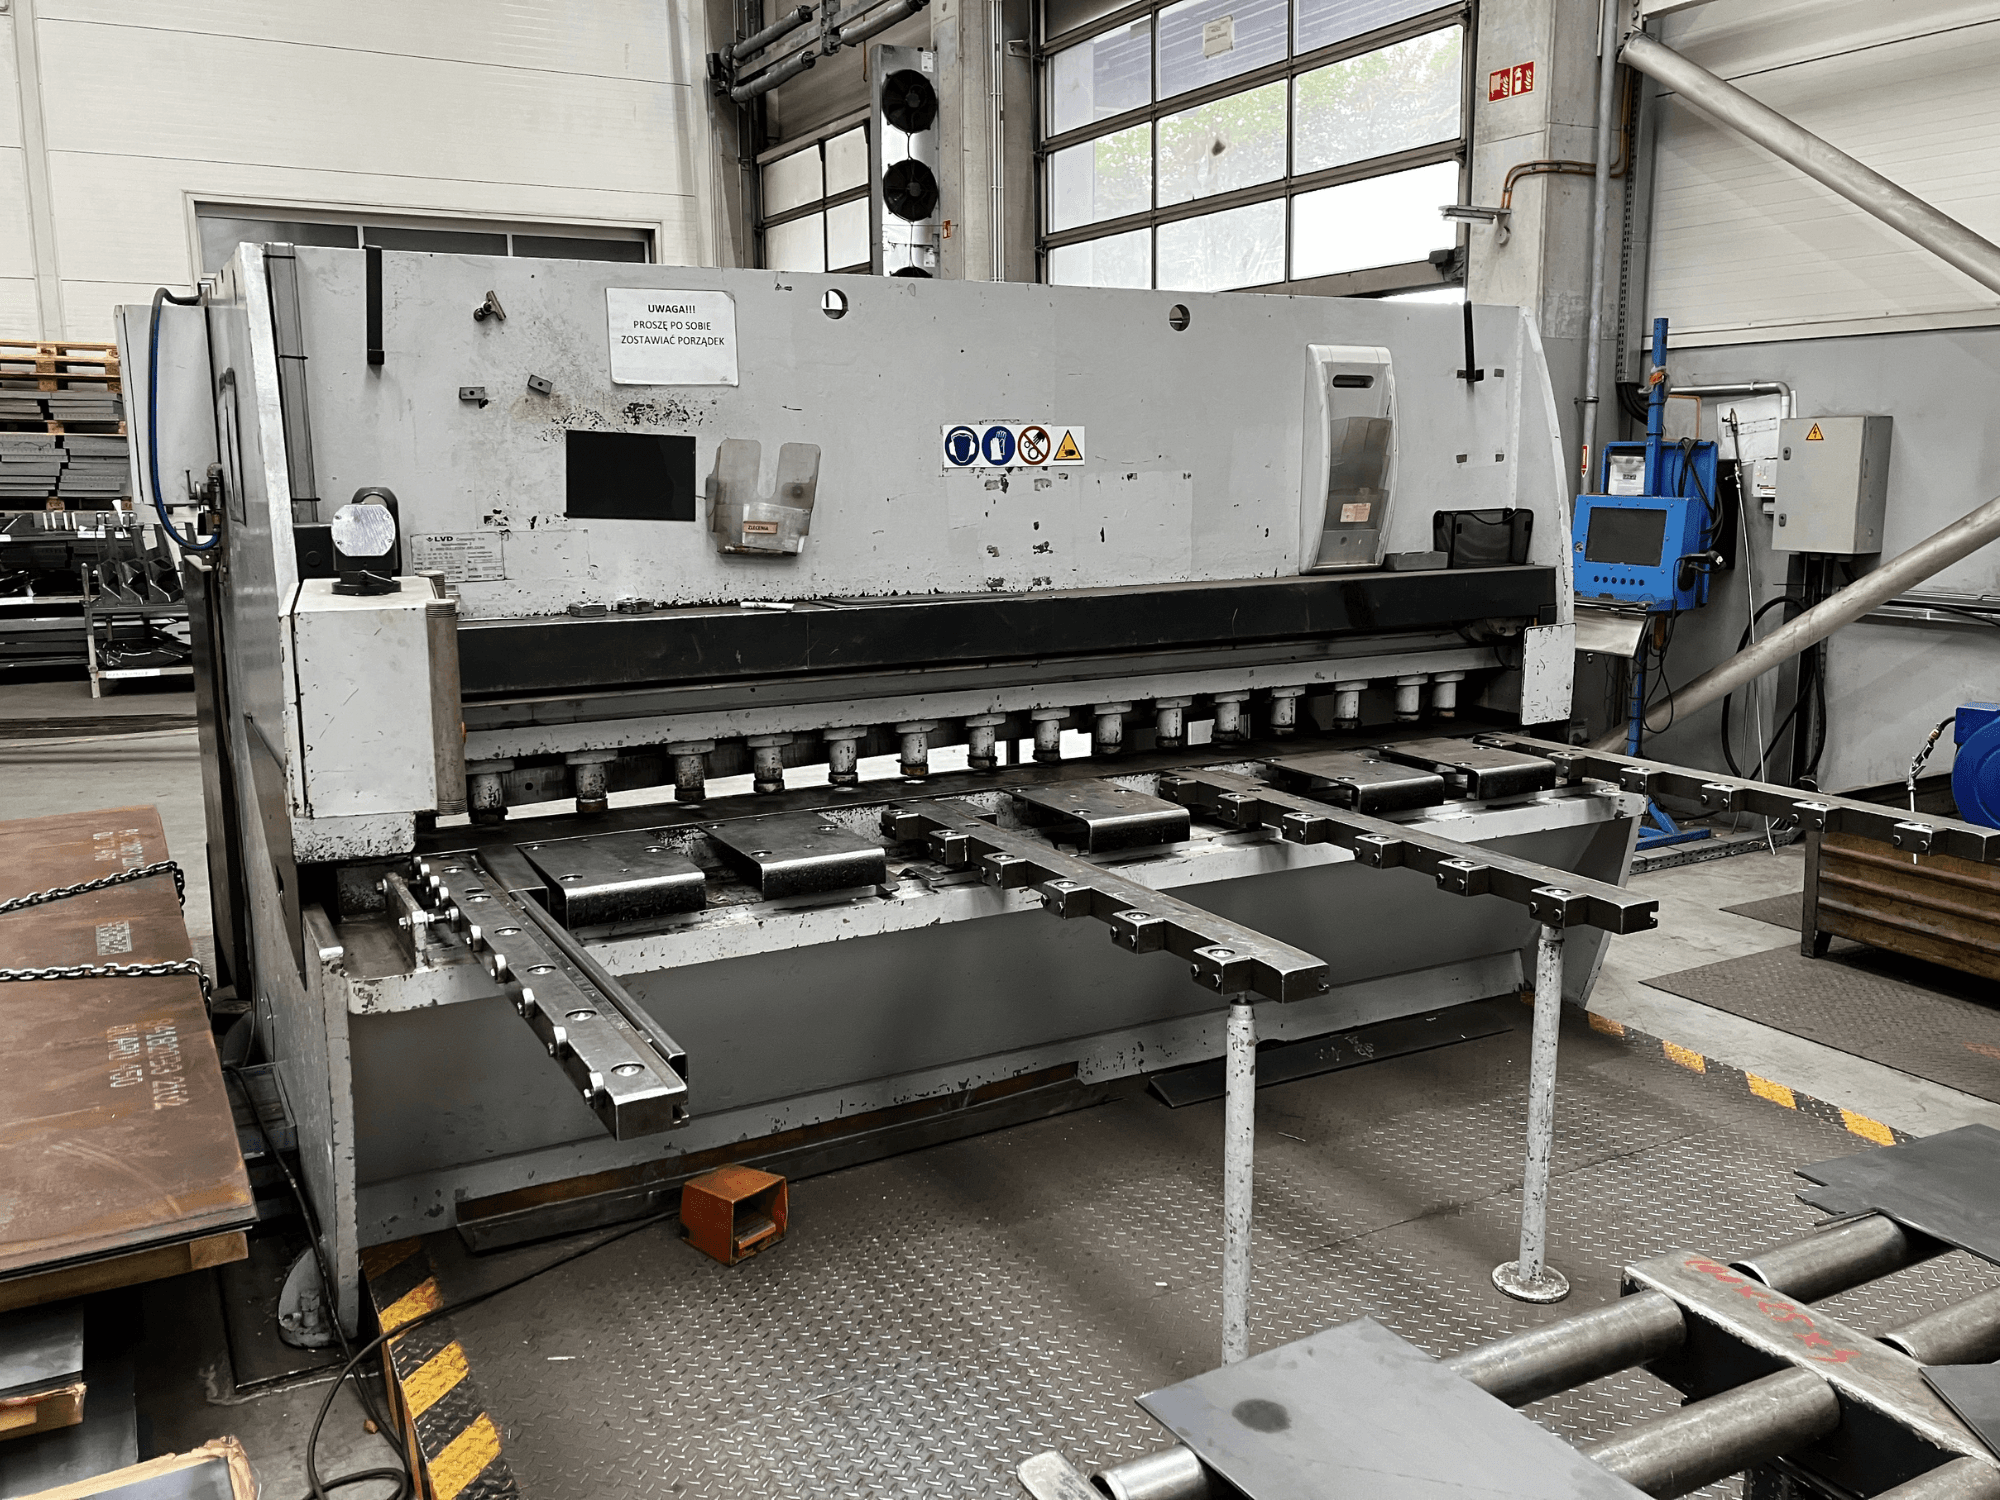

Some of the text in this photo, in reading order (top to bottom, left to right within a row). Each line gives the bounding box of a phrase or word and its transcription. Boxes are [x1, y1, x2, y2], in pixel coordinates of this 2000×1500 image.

[648, 304, 696, 314] UWAGA!!!
[633, 320, 711, 331] PROSZĘ PO SOBIE
[621, 334, 725, 347] ZOSTAWIAĆ PORZĄDEK
